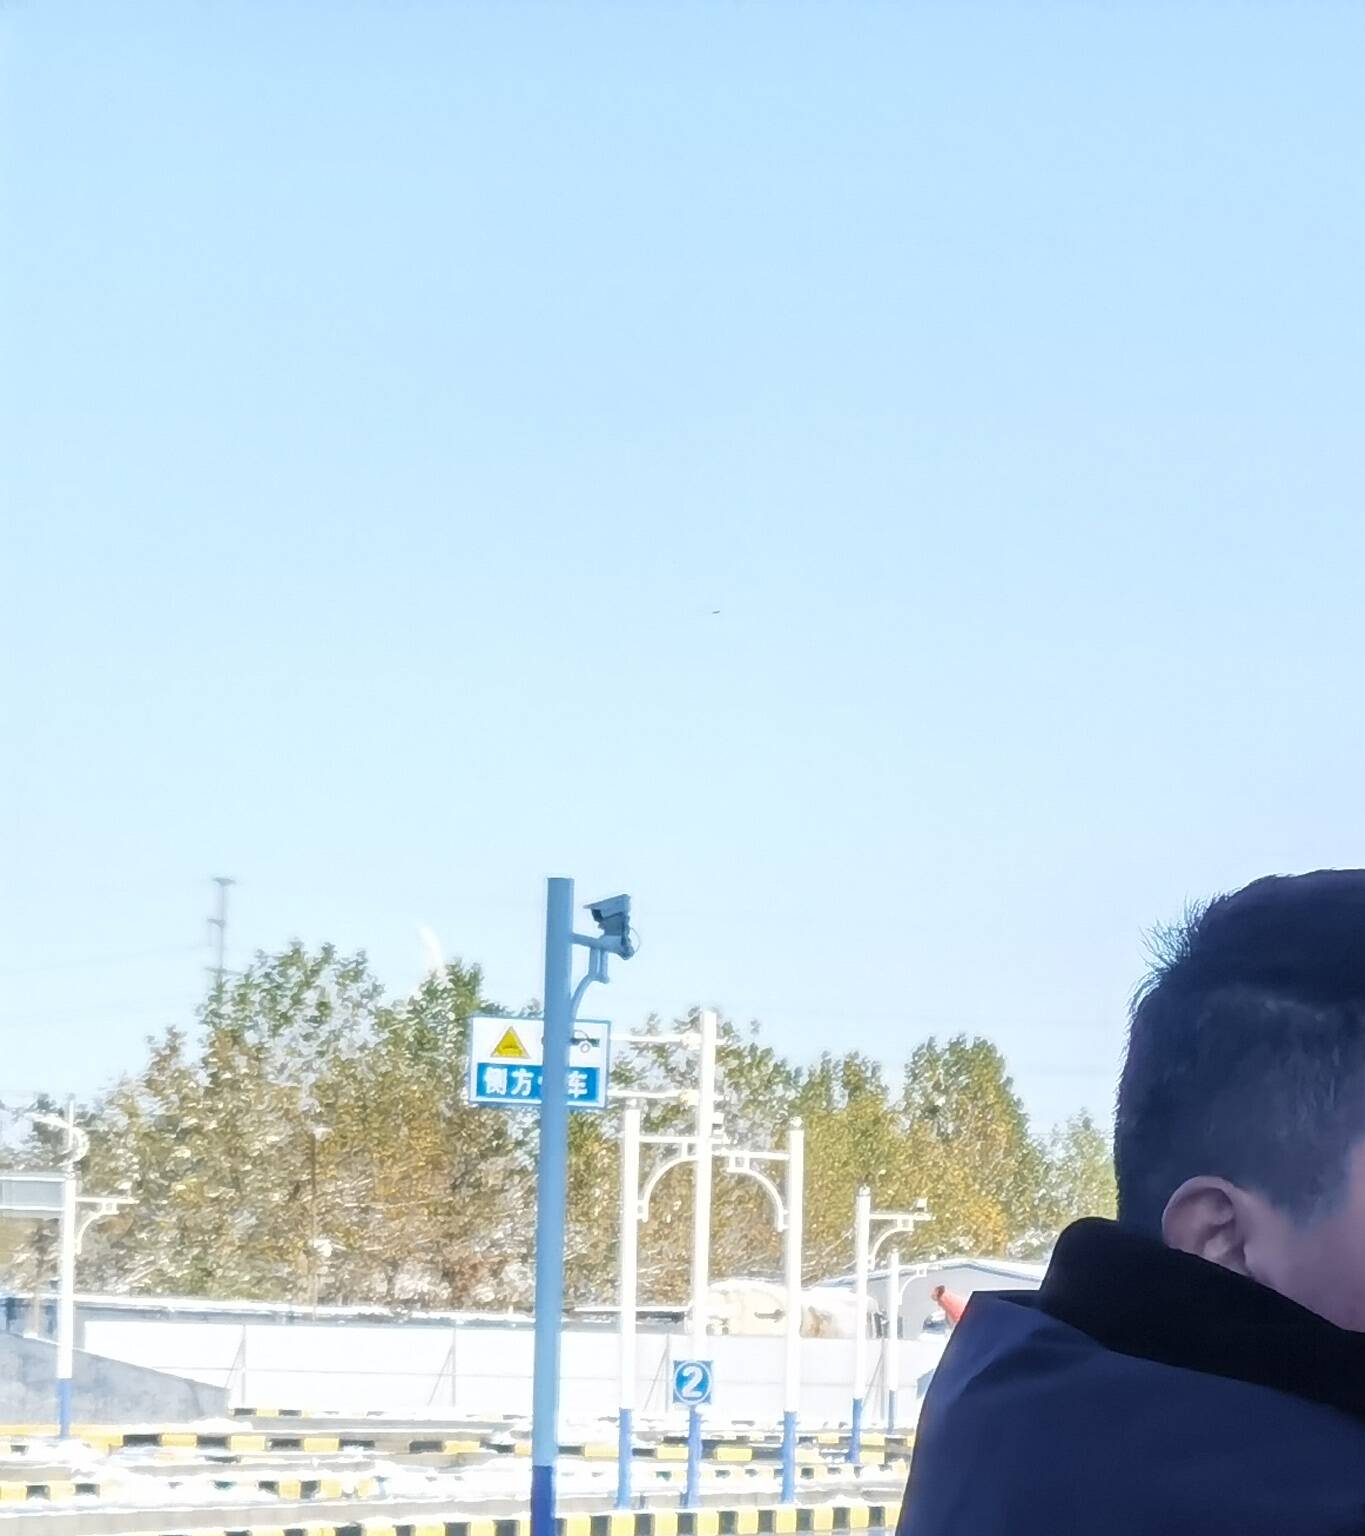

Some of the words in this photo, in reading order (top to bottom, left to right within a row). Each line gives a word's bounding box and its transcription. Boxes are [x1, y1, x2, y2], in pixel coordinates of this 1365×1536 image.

[484, 1066, 588, 1098] 侧方车
[682, 1366, 703, 1397] 2
